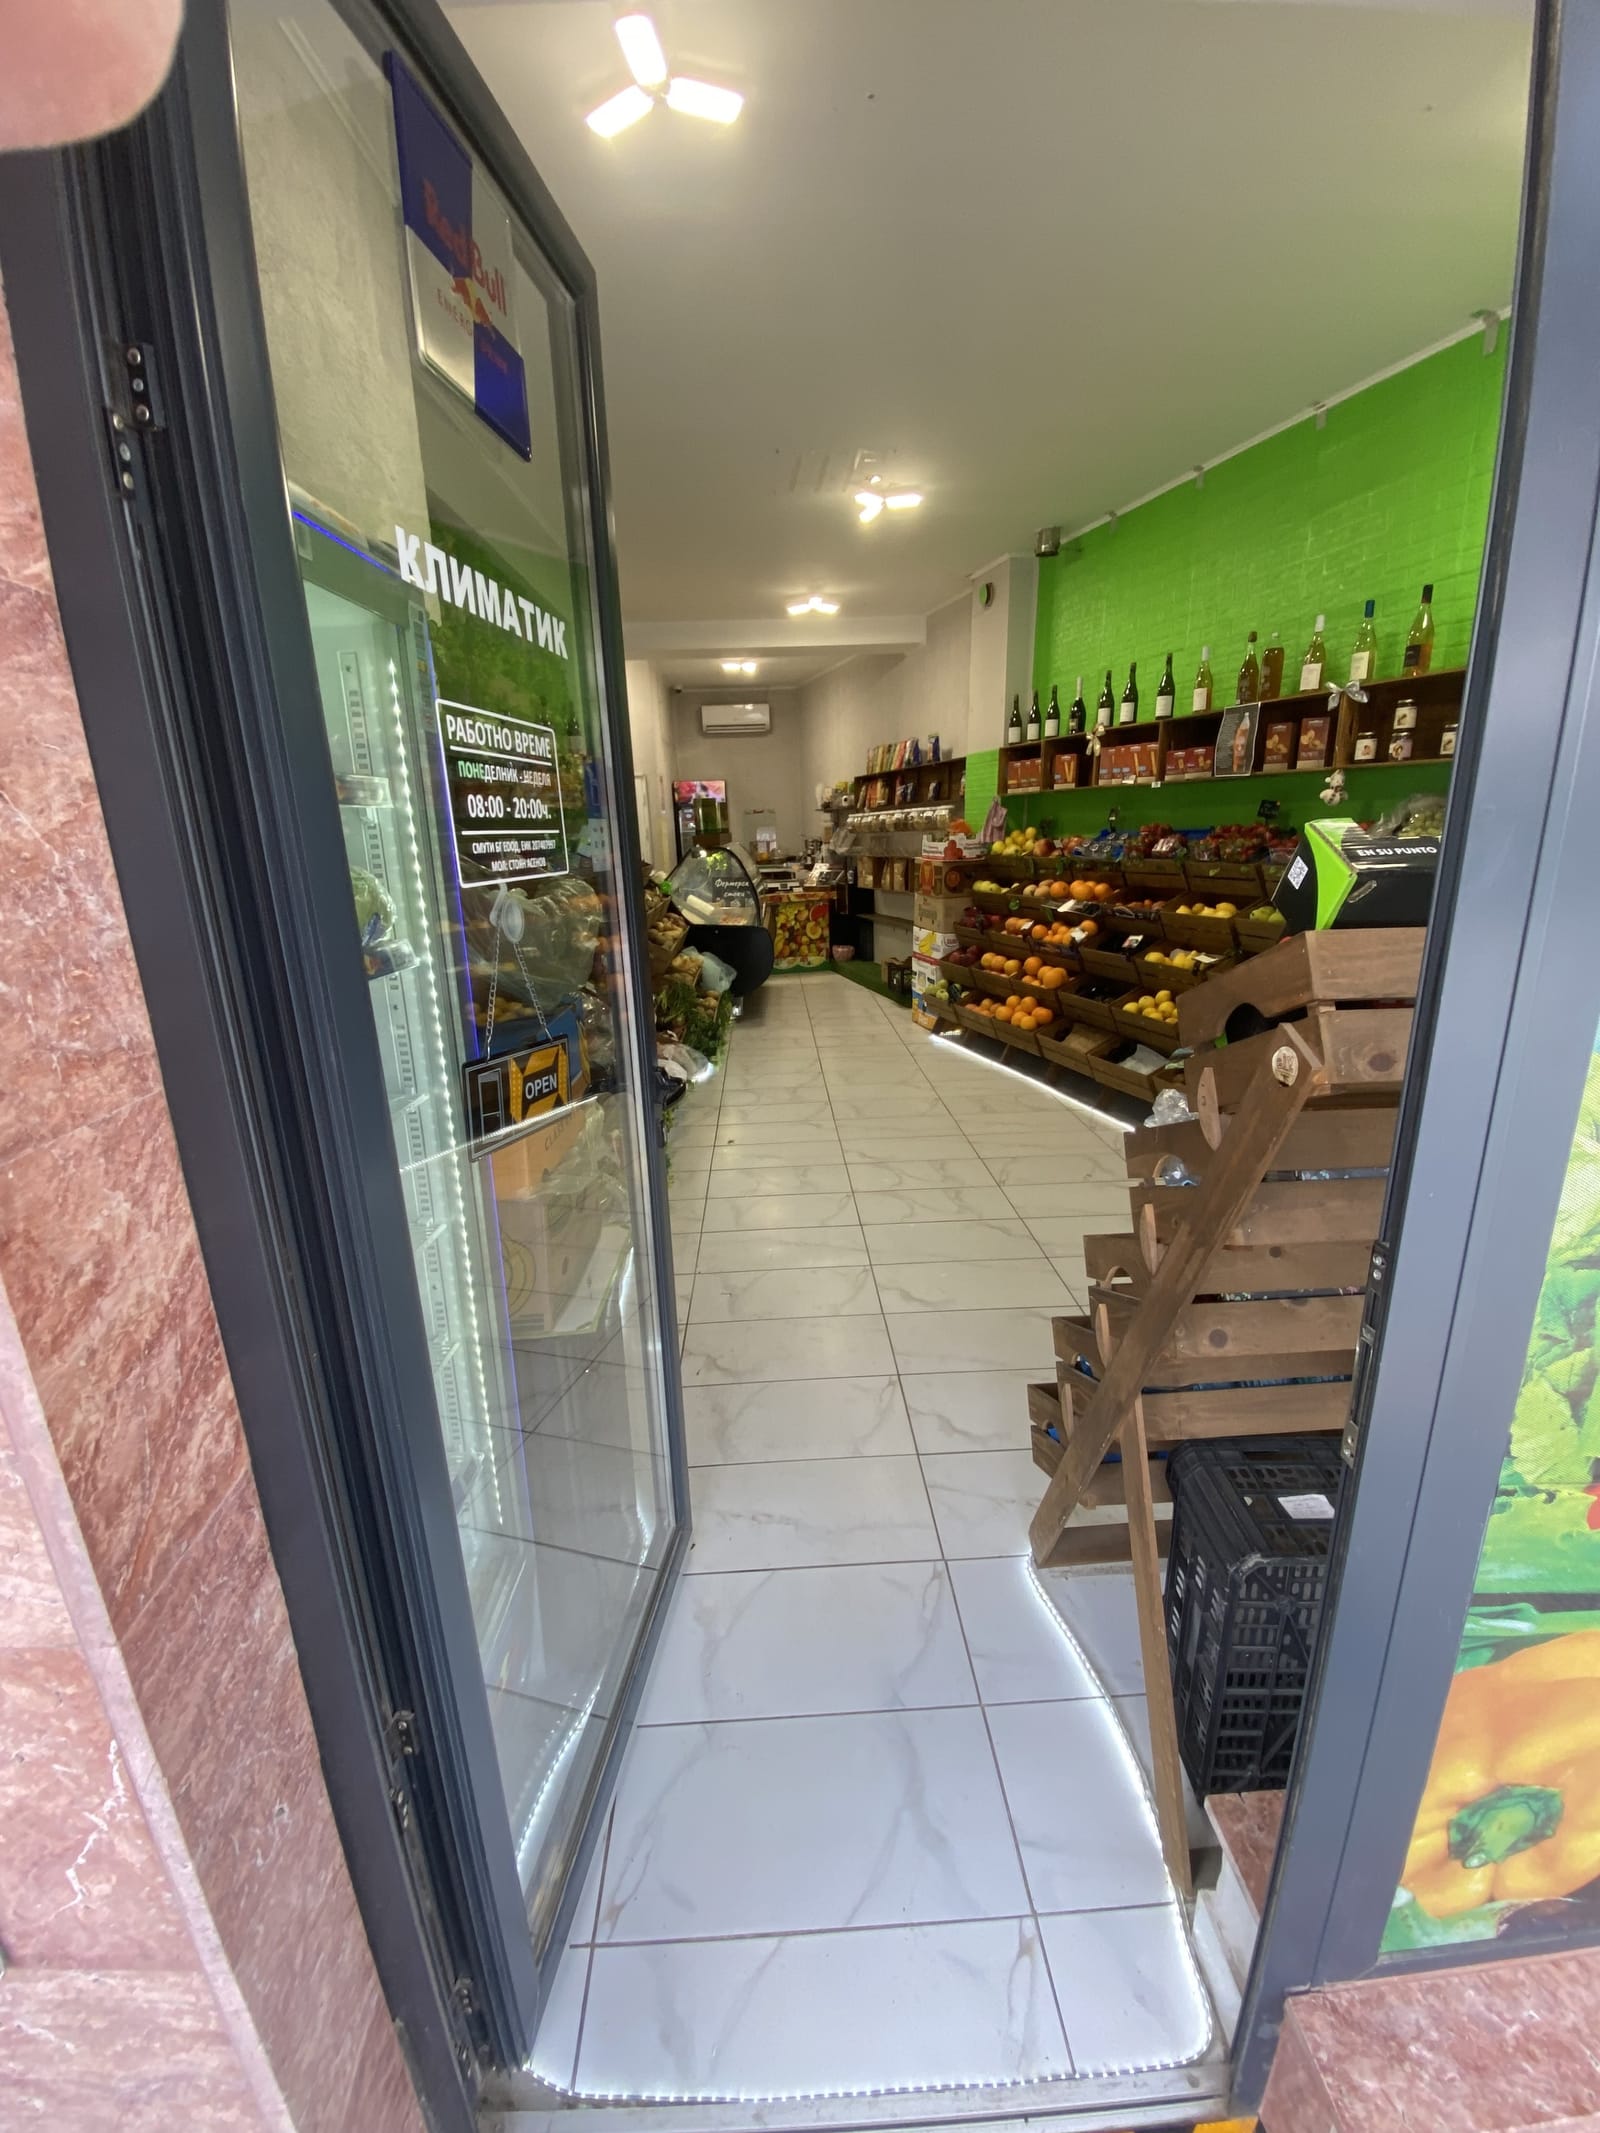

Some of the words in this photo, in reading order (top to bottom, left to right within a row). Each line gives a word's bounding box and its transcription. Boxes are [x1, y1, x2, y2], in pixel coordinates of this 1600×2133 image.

[470, 237, 508, 319] Bull
[395, 524, 569, 661] КЛИМАТИК
[445, 714, 512, 751] РАБОТНО
[514, 729, 552, 759] ВРЕМЕ
[457, 760, 519, 785] ПОНЕДЕЛНИК
[467, 793, 504, 819] 08:00
[1356, 849, 1376, 857] EN
[1375, 848, 1394, 856] SU
[1393, 846, 1438, 855] PUNTO
[525, 1072, 558, 1100] OPEN
